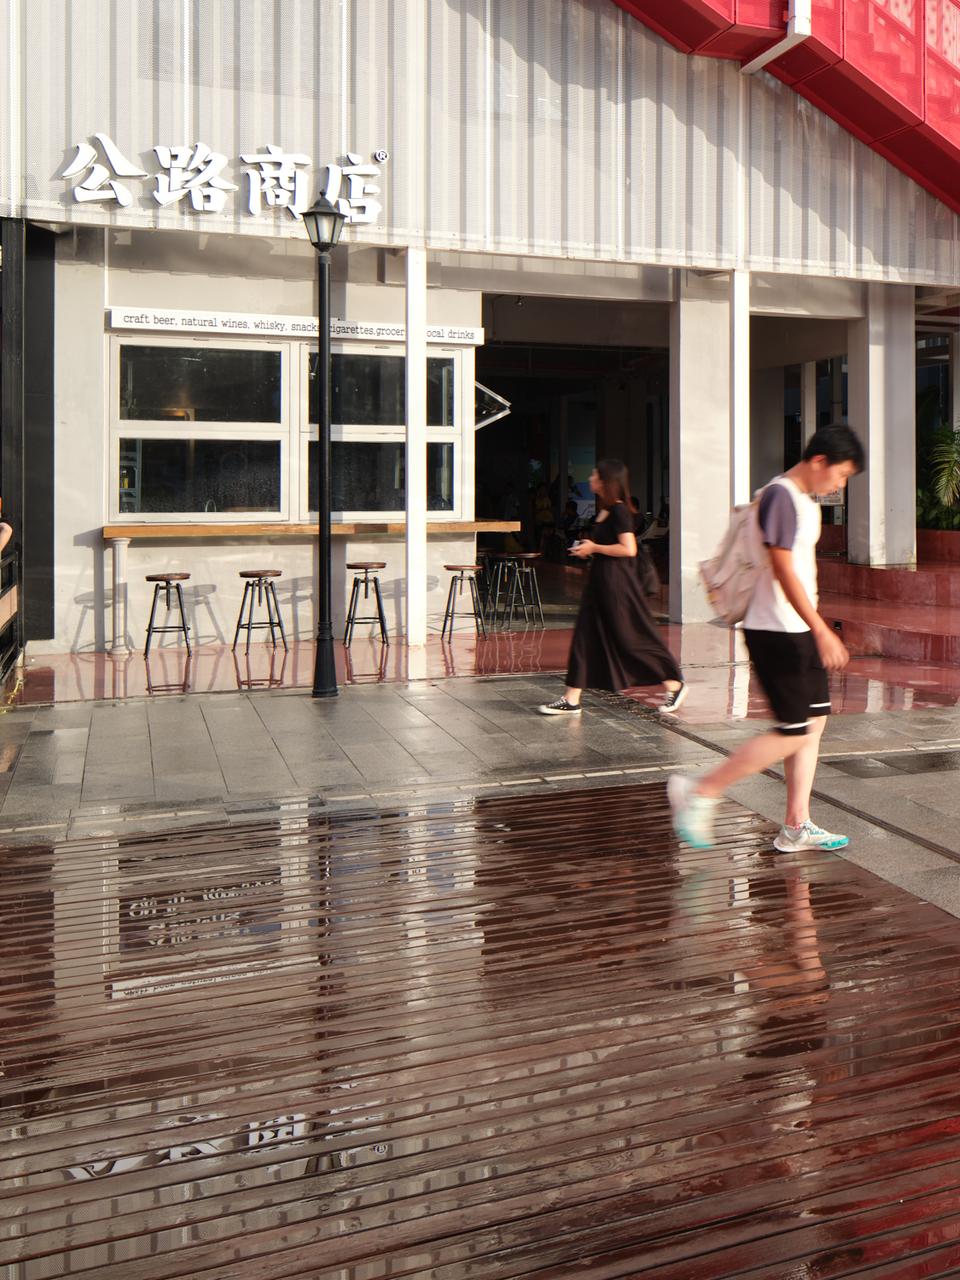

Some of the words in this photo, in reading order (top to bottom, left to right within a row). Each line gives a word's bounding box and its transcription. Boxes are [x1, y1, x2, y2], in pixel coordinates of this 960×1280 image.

[123, 313, 150, 324] craft
[181, 316, 218, 328] natural
[426, 328, 445, 339] ocal
[447, 330, 476, 340] drinks
